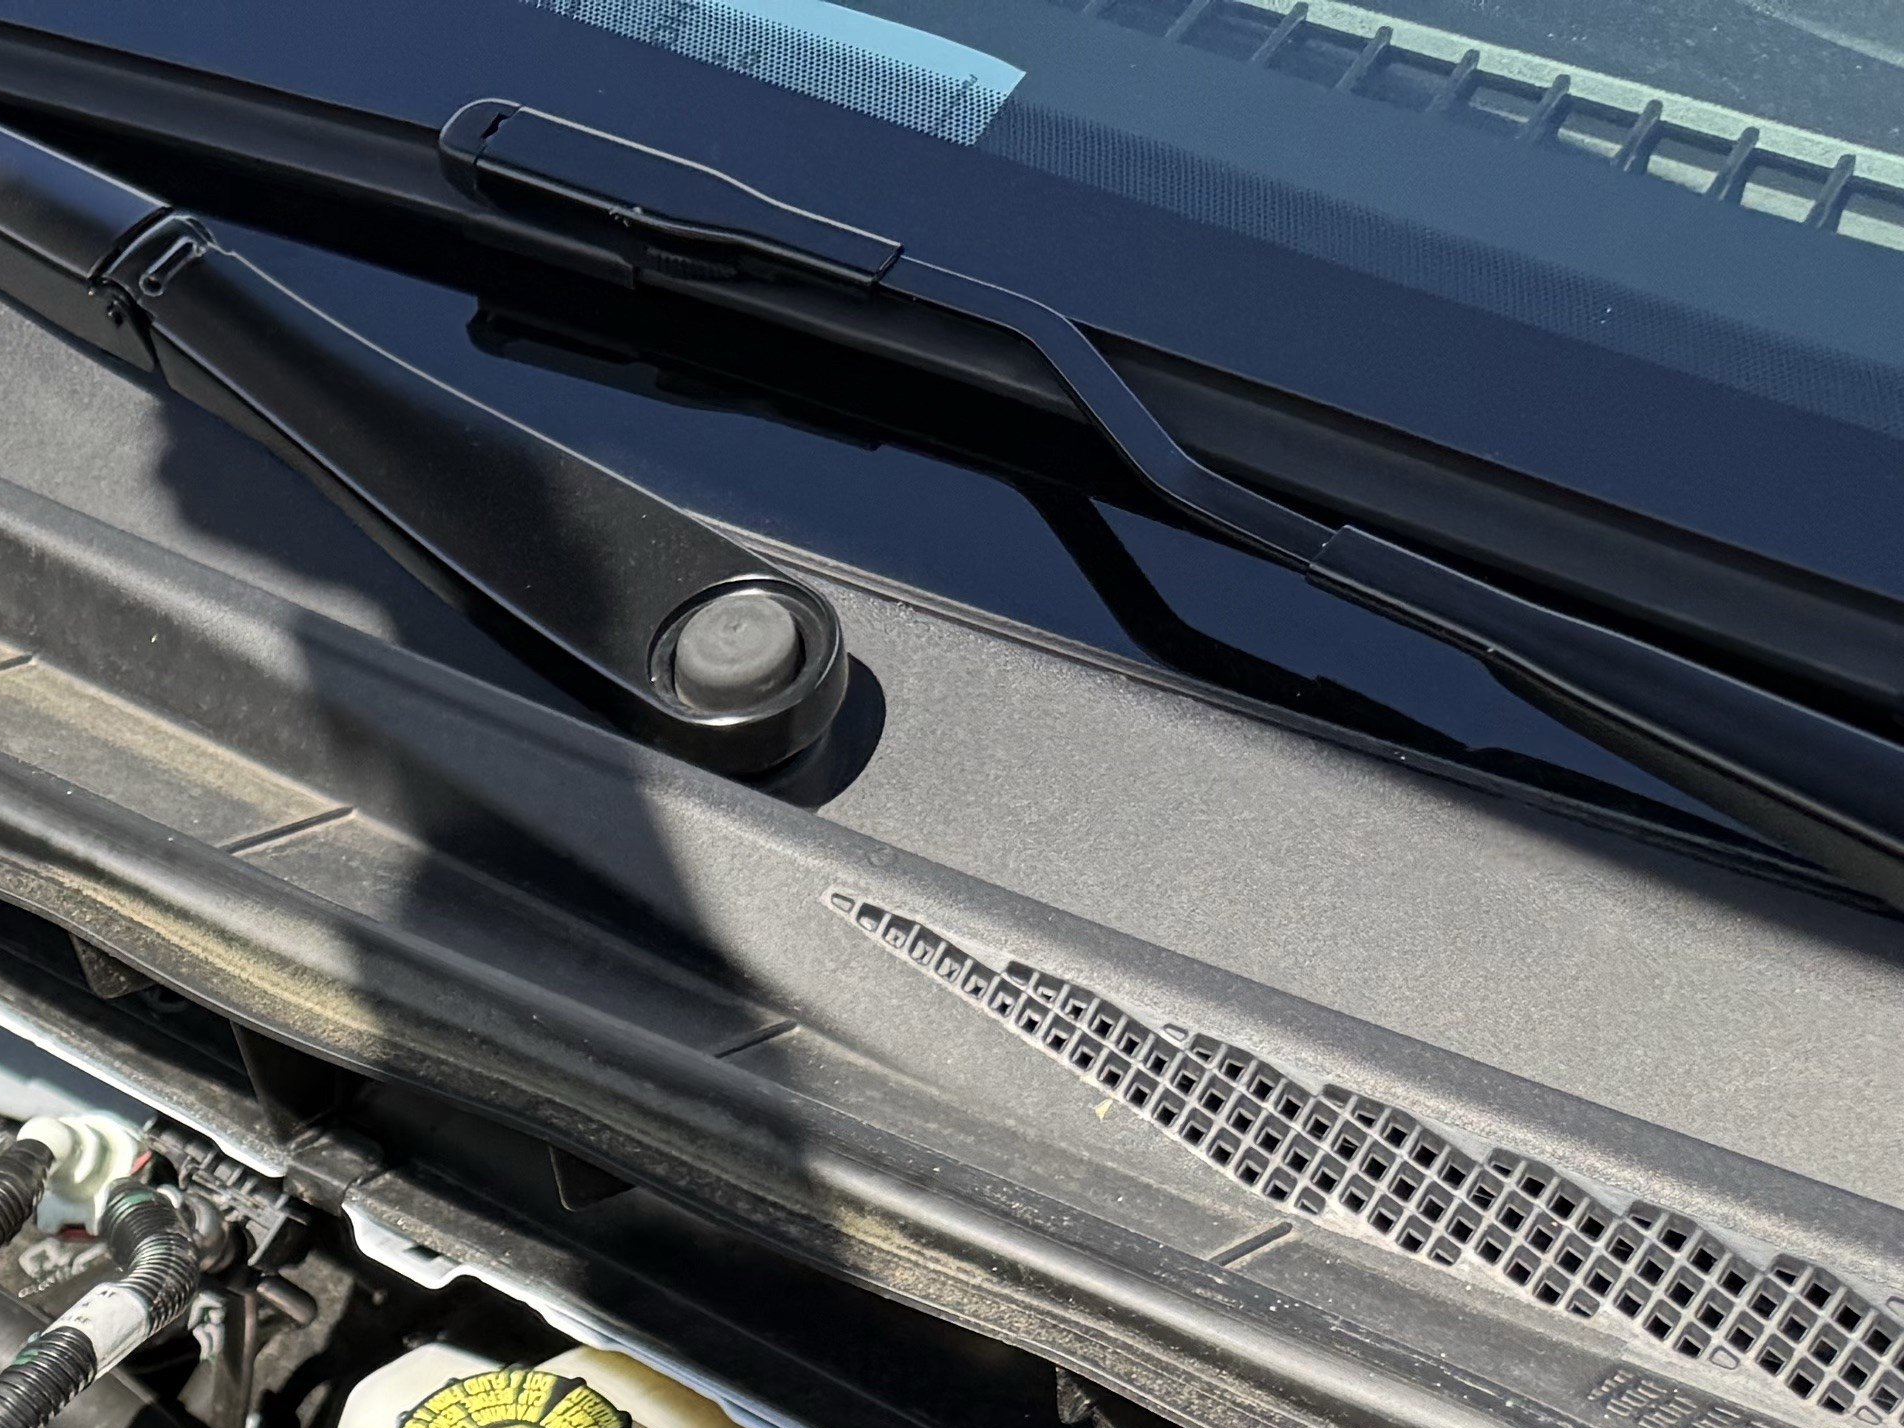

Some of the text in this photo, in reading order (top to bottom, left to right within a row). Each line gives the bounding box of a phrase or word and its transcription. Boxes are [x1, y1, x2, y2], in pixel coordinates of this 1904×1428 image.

[459, 1371, 507, 1395] FLUID
[522, 1369, 558, 1394] DOT
[517, 1388, 548, 1408] CAP
